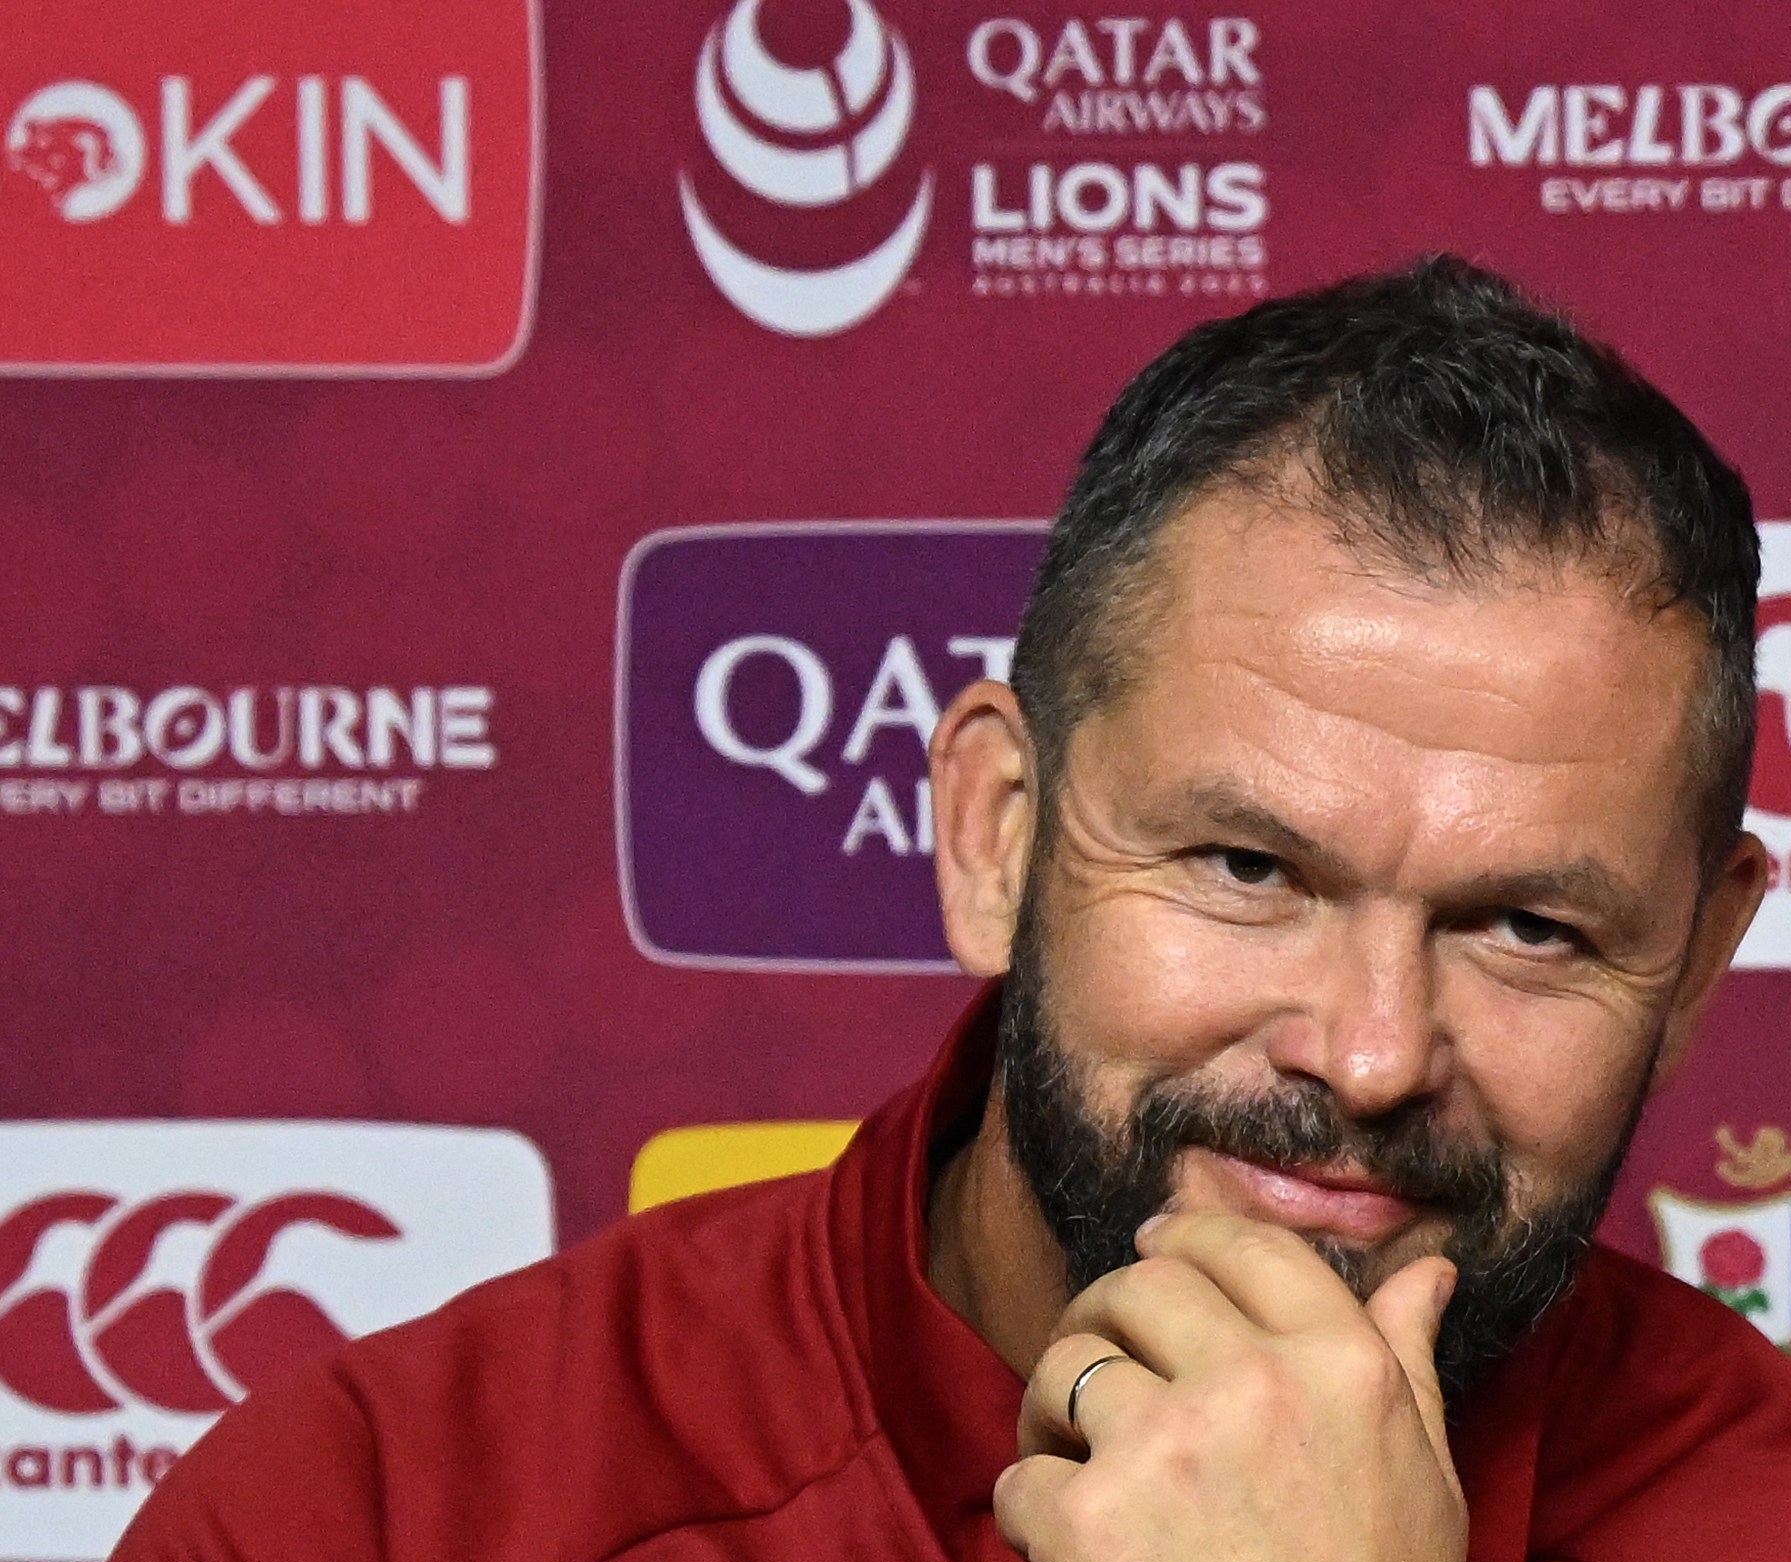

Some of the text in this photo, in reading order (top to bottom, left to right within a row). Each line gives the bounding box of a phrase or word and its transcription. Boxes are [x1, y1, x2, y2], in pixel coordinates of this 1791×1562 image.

[967, 17, 1261, 102] QATAR
[1042, 90, 1266, 134] AIRWAYS
[971, 162, 1268, 232] LIONS
[1541, 178, 1690, 211] EVERY
[1701, 178, 1769, 211] BIT
[99, 778, 167, 814] BIT
[178, 778, 424, 814] DIFFERENT
